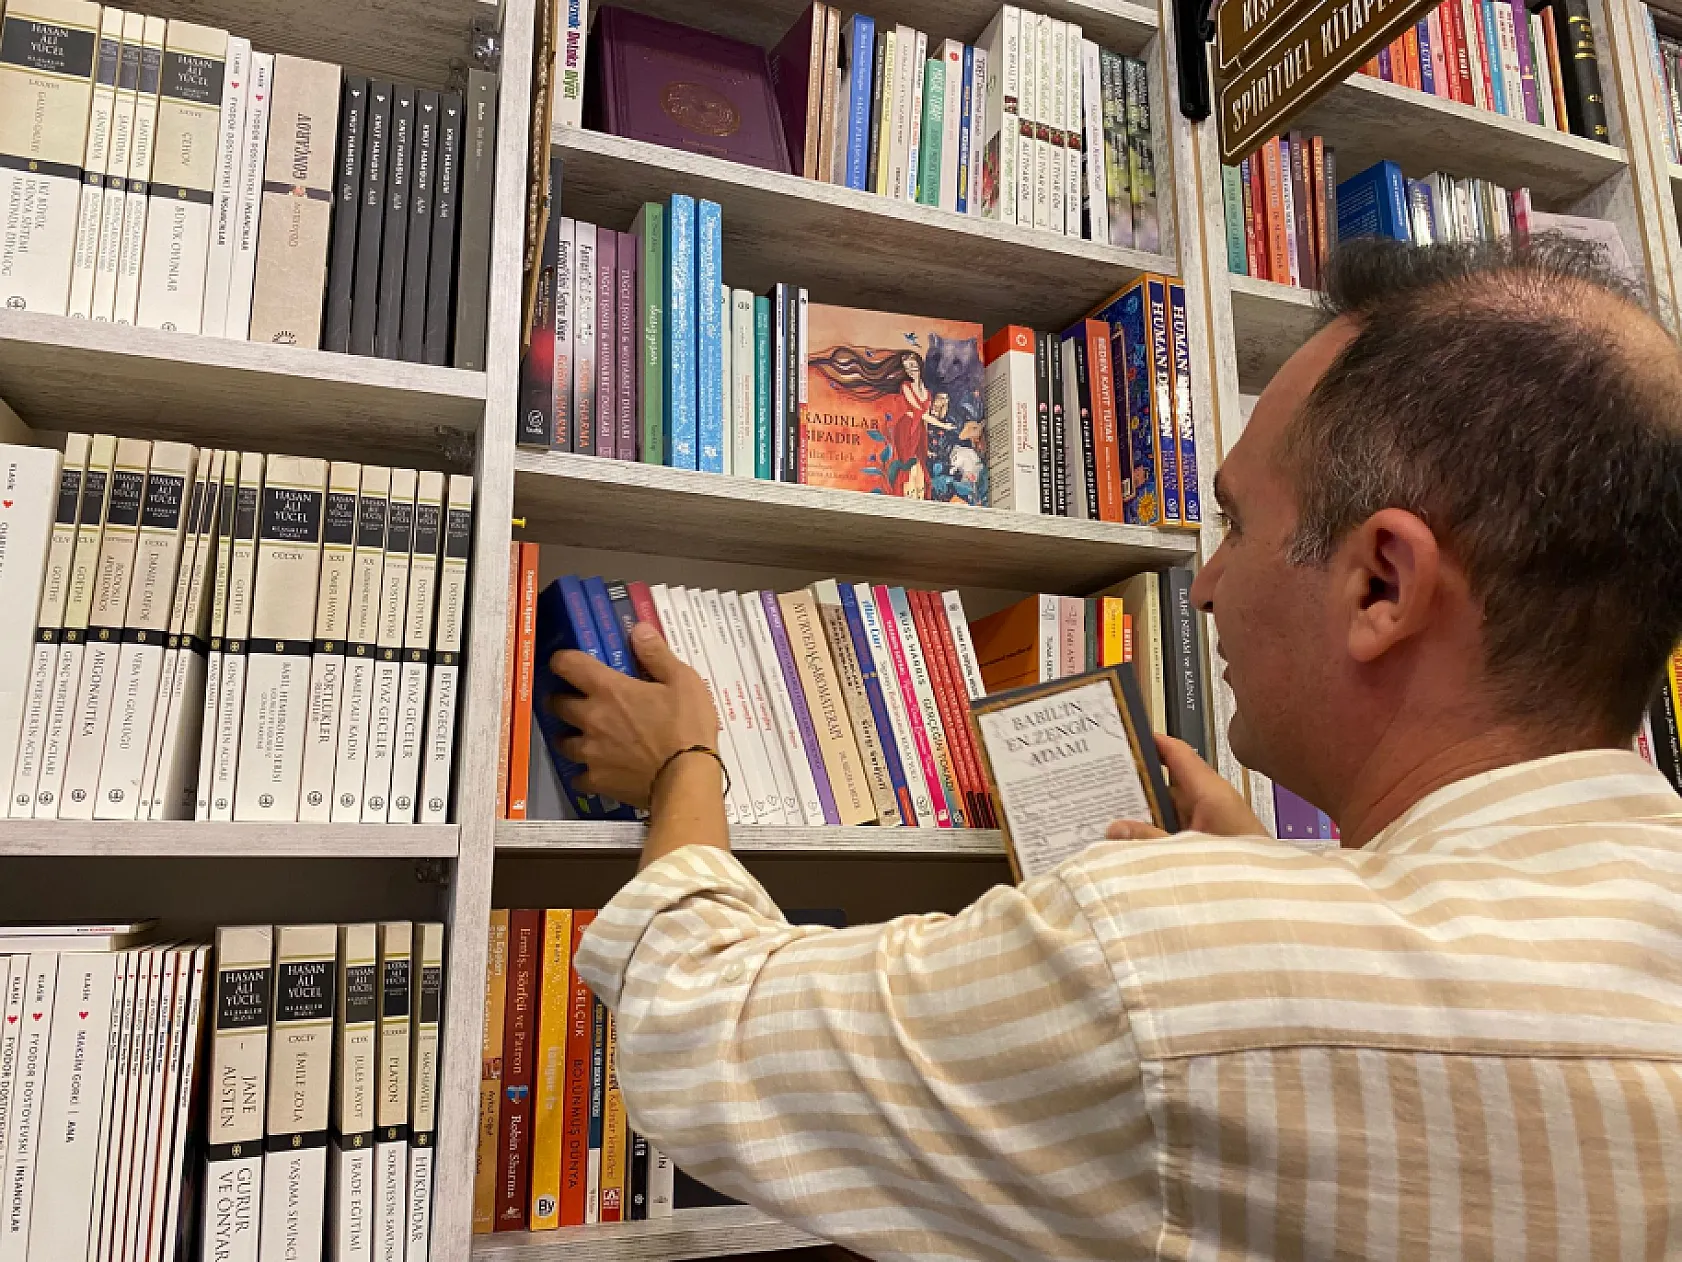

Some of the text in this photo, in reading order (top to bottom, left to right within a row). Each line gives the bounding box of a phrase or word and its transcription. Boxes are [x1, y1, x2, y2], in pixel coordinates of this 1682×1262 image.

[1233, 0, 1394, 133] SPİRİTÜEL KİTAP
[1151, 301, 1167, 368] HUMAN
[1172, 305, 1189, 372] HUMAN
[275, 491, 312, 503] HASAN
[899, 610, 913, 641] RUSS
[907, 643, 926, 686] HARRIS
[374, 668, 392, 760] BEYAZ GECELER
[402, 708, 417, 760] GECELER
[434, 672, 452, 762] BEYAZ GECELER
[82, 972, 93, 1002] KLASİK
[226, 971, 264, 984] HASAN
[288, 964, 325, 976] HASAN
[288, 986, 323, 998] YÜCEL
[226, 993, 262, 1007] YÜCEL
[516, 1014, 525, 1029] ve
[573, 989, 587, 1037] SELÇUK
[0, 1035, 16, 1079] FYODOR
[25, 1032, 40, 1078] FYODOR
[514, 1031, 526, 1074] Patron
[65, 1030, 87, 1143] MAKSİM GORKİ ANA
[220, 1065, 237, 1128] AUSTEN
[241, 1075, 257, 1114] JANE
[353, 1054, 365, 1118] JULES PAYOT
[388, 1056, 400, 1103] PLATON
[294, 1090, 306, 1123] ZOLA
[566, 1058, 585, 1189] BÖLÜNMÜŞ DÜNYA
[506, 1114, 523, 1199] Robin Sharma
[10, 1164, 26, 1233] İNSANCIKLAR
[218, 1171, 234, 1193] VE
[235, 1167, 253, 1233] GURUR
[412, 1156, 428, 1242] HÜKÜMDAR
